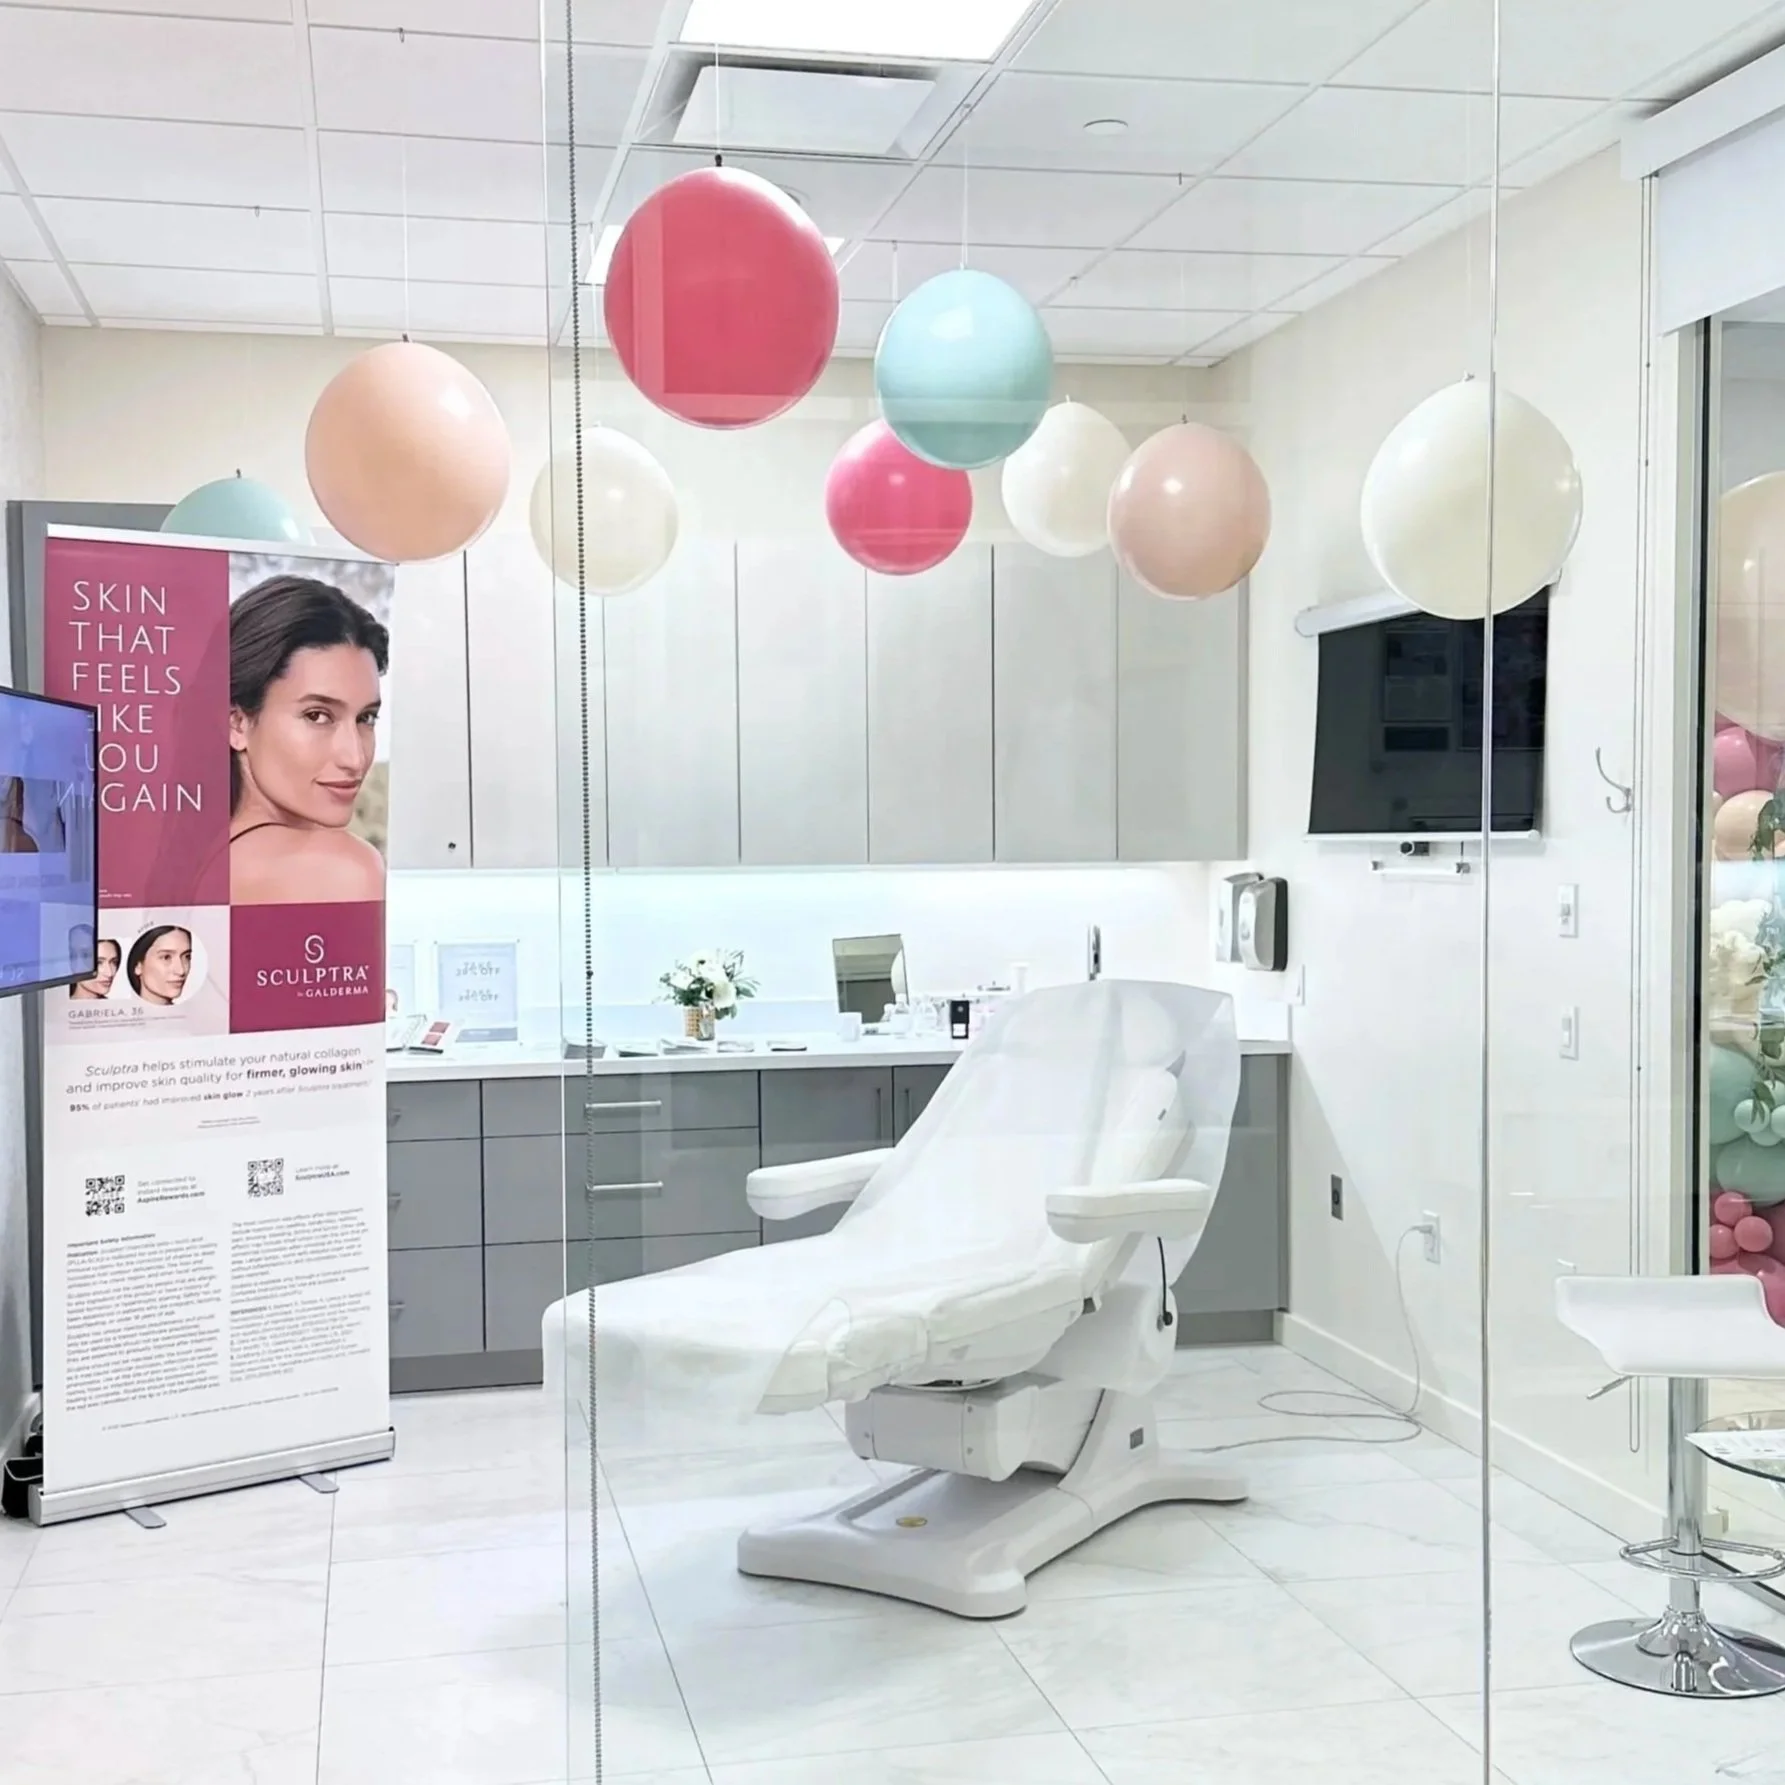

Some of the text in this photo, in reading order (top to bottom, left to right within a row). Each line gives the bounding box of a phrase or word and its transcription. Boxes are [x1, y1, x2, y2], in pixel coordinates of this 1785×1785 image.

[72, 580, 166, 615] SKIN
[68, 621, 175, 656] THAT
[72, 661, 182, 696] FEELS
[97, 703, 154, 734] IKE
[98, 742, 159, 773] OU
[101, 782, 202, 812] GAIN
[304, 985, 369, 998] GALDERMA
[85, 1046, 361, 1077] Sculptra helps stimulate your natural collagen
[66, 1081, 92, 1094] and
[96, 1078, 149, 1093] improve
[151, 1075, 177, 1088] skin
[180, 1072, 223, 1087] quality
[225, 1070, 243, 1081] for
[246, 1066, 286, 1080] firmer,
[289, 1063, 337, 1078] glowing
[69, 1103, 90, 1113] 95%
[203, 1092, 221, 1101] skin
[223, 1091, 244, 1101] glow
